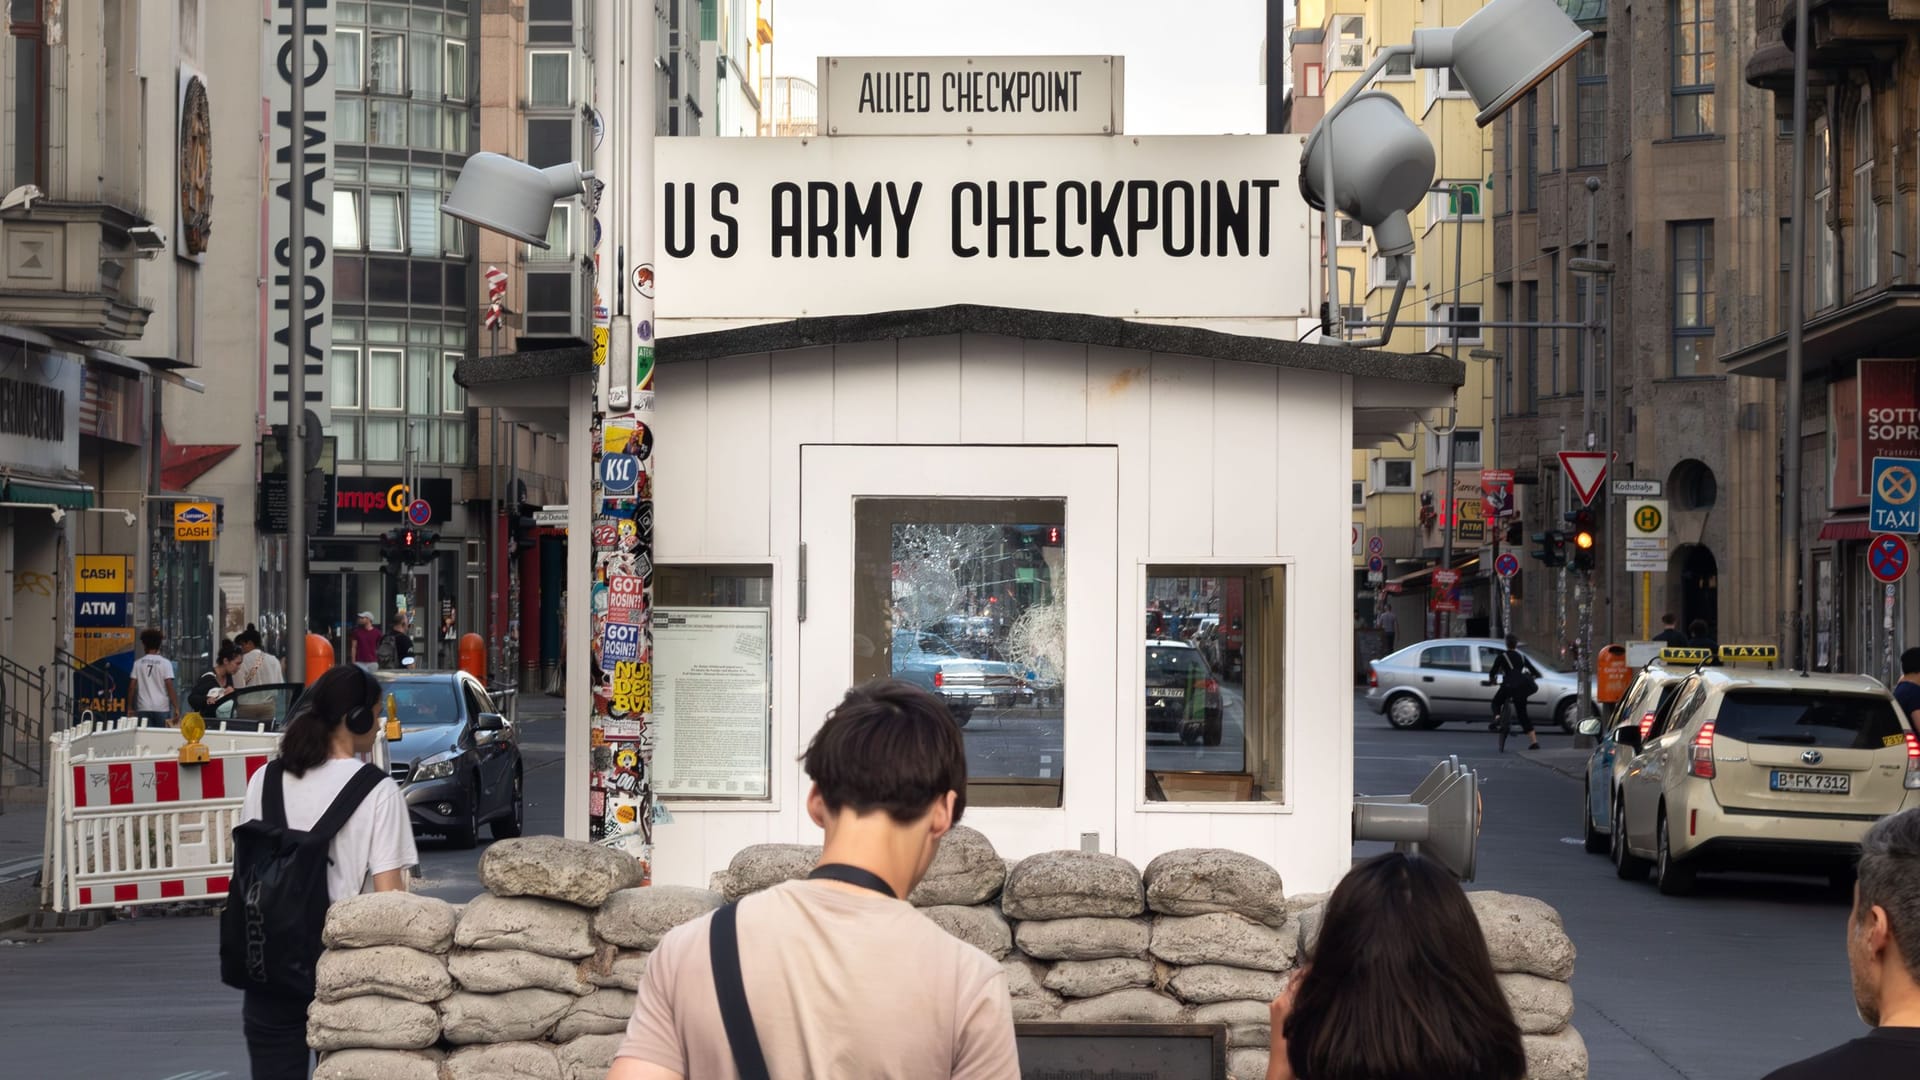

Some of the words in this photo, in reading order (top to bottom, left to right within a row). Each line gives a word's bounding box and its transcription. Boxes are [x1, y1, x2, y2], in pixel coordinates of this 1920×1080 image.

[858, 71, 930, 113] ALLIED
[942, 70, 1082, 112] CHECKPOINT
[275, 111, 327, 216] AM
[664, 181, 739, 259] US
[771, 181, 923, 259] ARMY
[951, 179, 1280, 258] CHECKPOINT
[272, 236, 326, 402] HAUS
[1868, 425, 1920, 440] SOPR
[605, 458, 632, 482] KSC
[1876, 509, 1915, 527] TAXI
[178, 527, 209, 537] CASH
[1461, 522, 1482, 531] ATM
[80, 568, 116, 579] CASH
[612, 577, 642, 592] GOT
[80, 602, 116, 615] ATM
[610, 592, 641, 609] ROSIN??
[607, 625, 637, 642] GOT
[604, 640, 636, 658] ROSIN??
[1670, 649, 1704, 659] TAXI
[1731, 646, 1770, 657] TAXI
[147, 664, 154, 678] 7
[1779, 774, 1787, 787] B
[1796, 775, 1813, 788] FK
[1815, 775, 1848, 790] 7312
